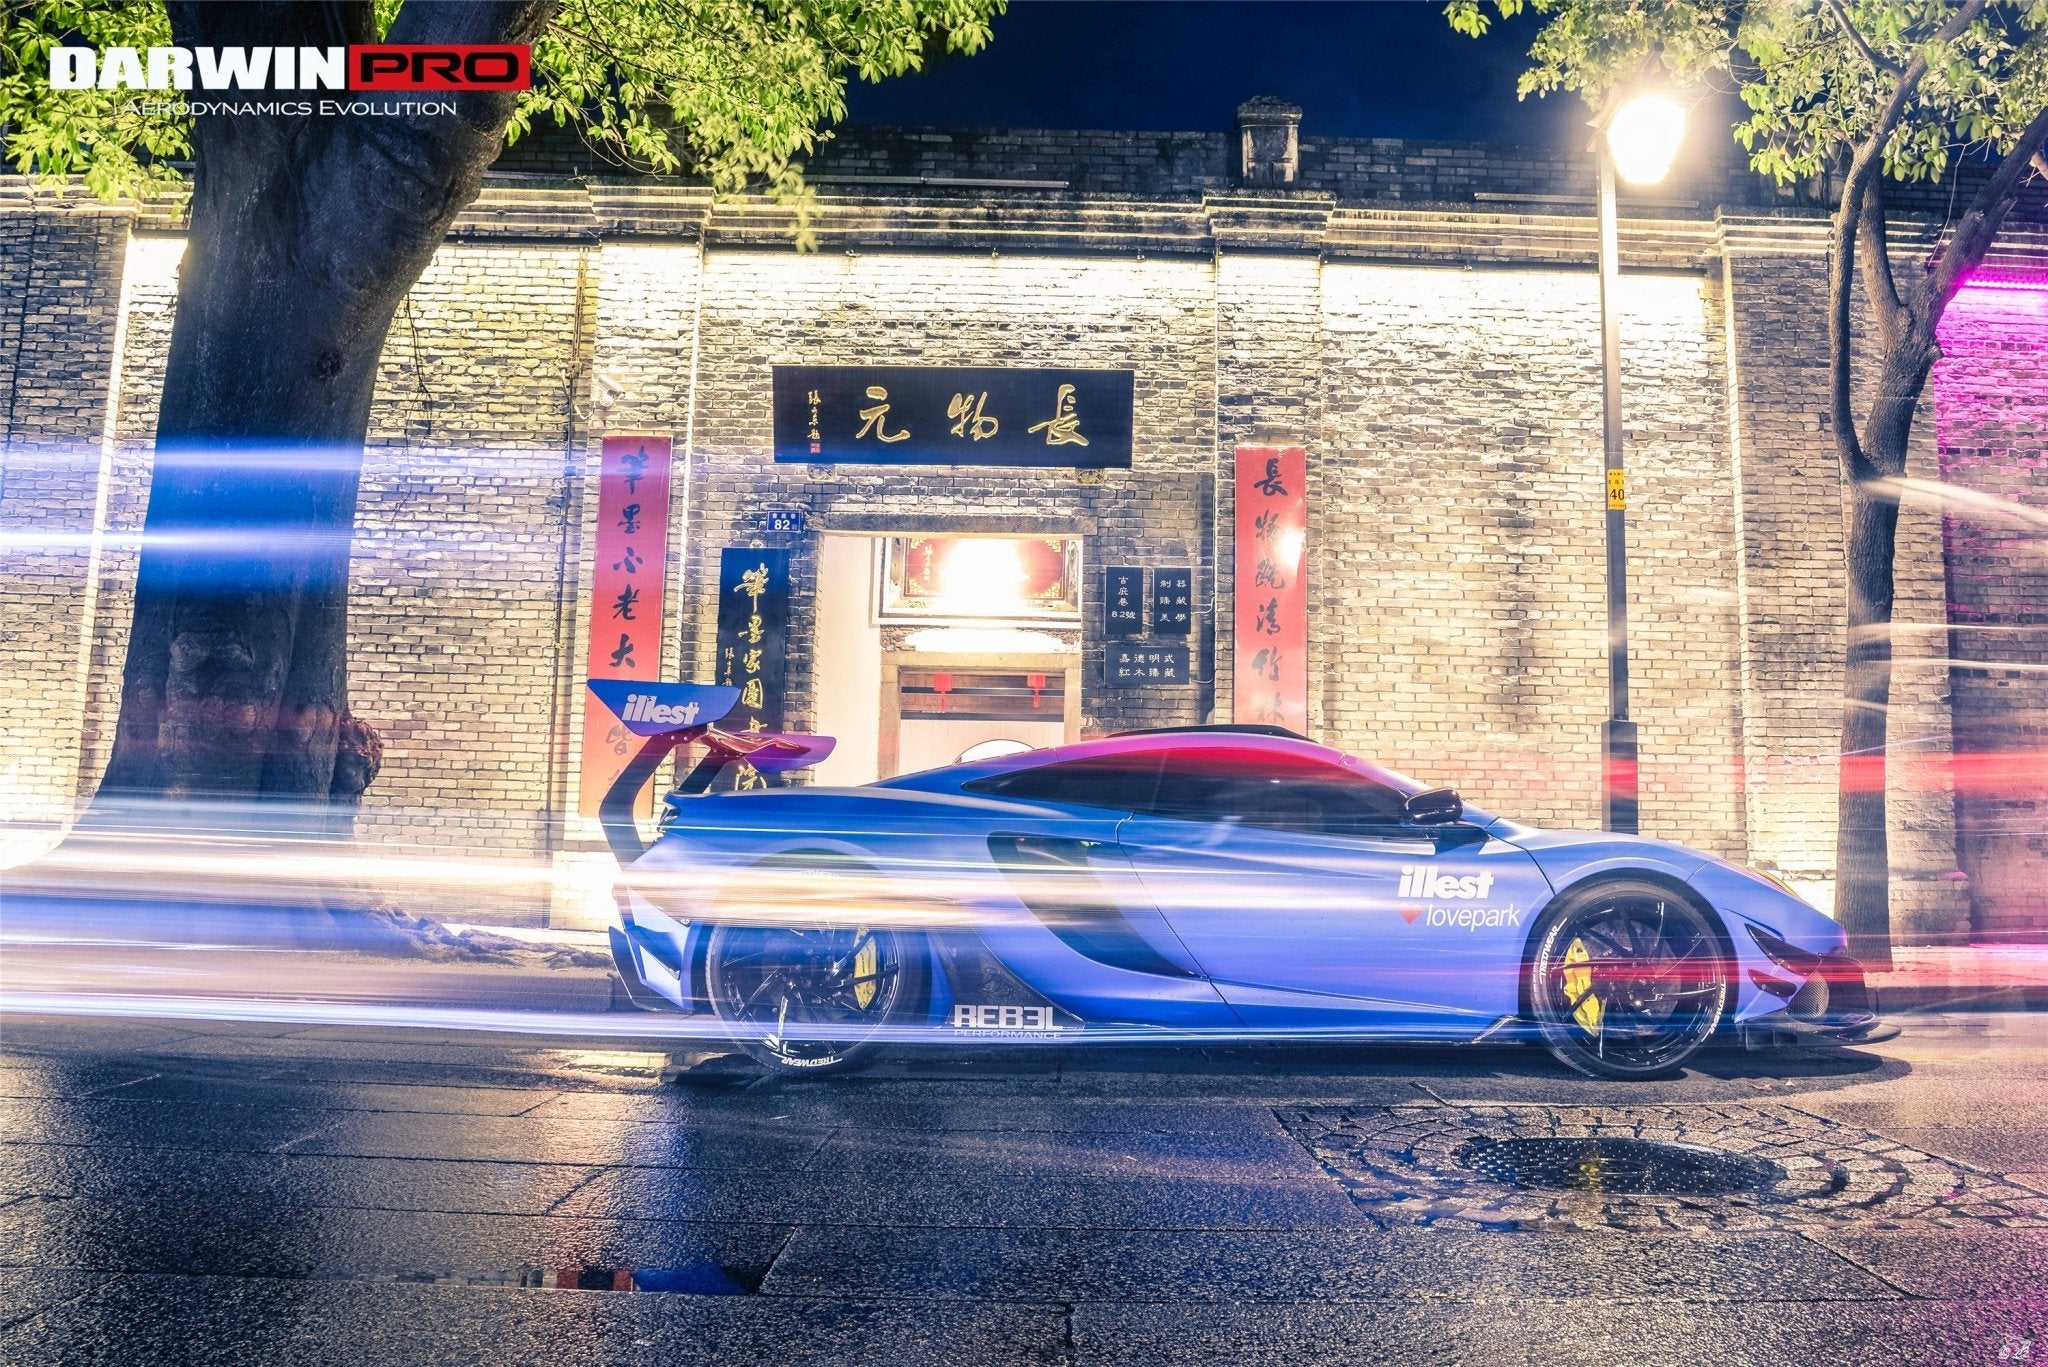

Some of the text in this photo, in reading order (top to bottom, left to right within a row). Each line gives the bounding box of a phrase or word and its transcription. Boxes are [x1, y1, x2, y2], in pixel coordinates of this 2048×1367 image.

[1610, 489, 1625, 500] 40
[774, 519, 791, 530] 82
[622, 694, 699, 725] illest
[1398, 865, 1494, 899] illest
[1426, 903, 1521, 933] lovepark
[954, 1030, 1062, 1040] PERFORMANCE
